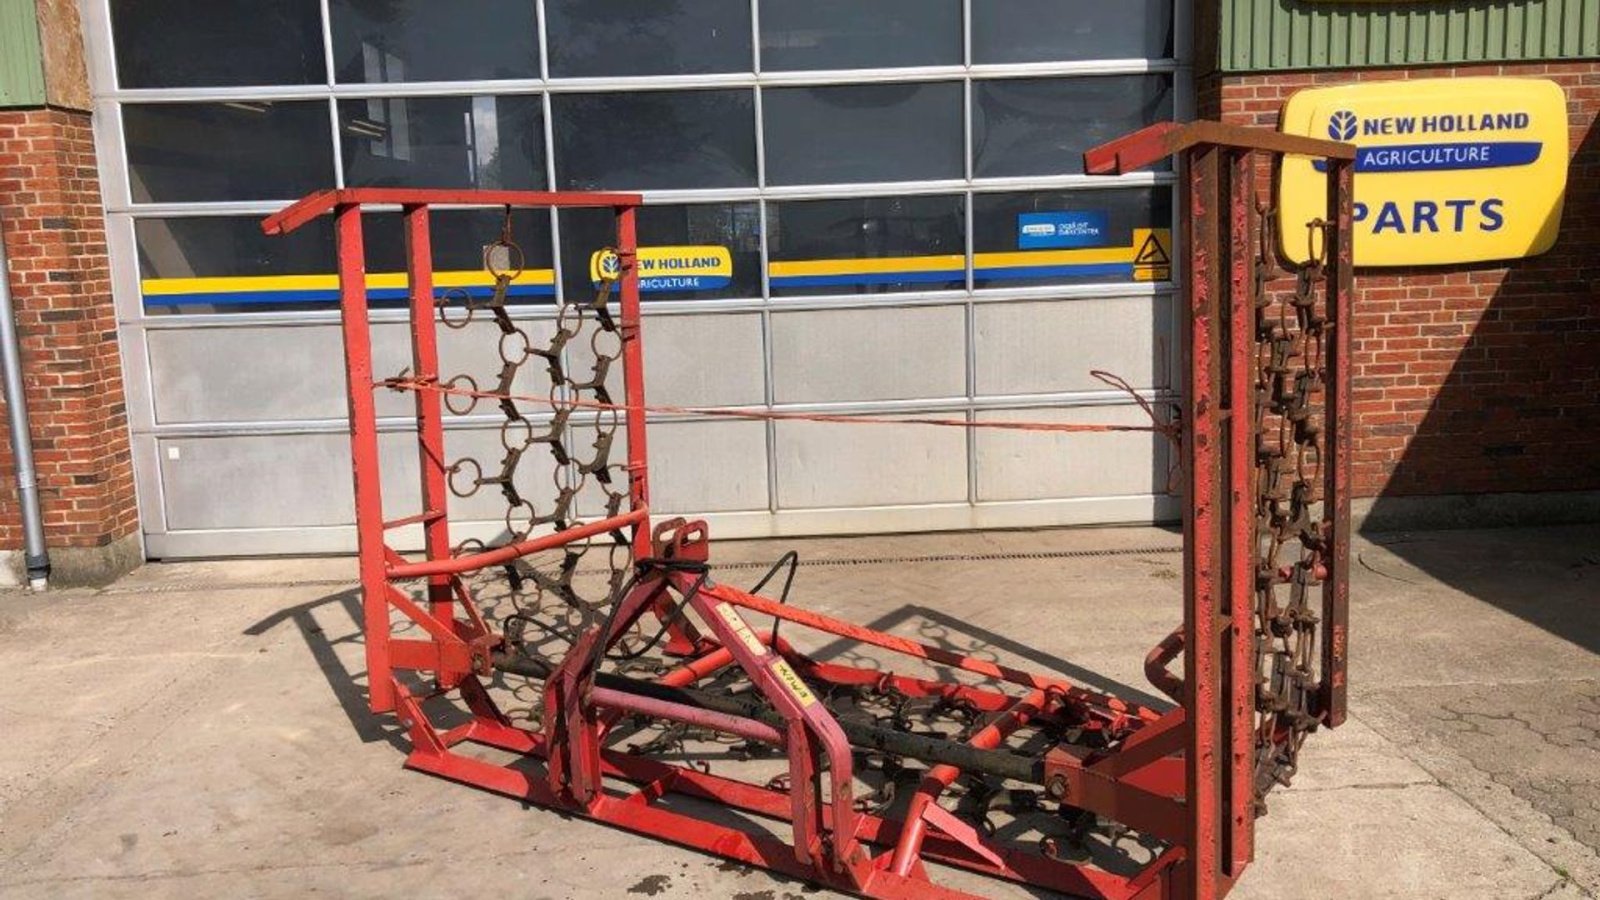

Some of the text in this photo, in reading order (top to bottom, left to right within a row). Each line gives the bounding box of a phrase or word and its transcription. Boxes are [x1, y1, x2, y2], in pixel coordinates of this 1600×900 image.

[1363, 112, 1529, 135] NEW HOLLAND
[1363, 146, 1490, 166] AGRICULTURE
[659, 257, 721, 269] HOLLAND
[637, 277, 699, 289] RICULTURE
